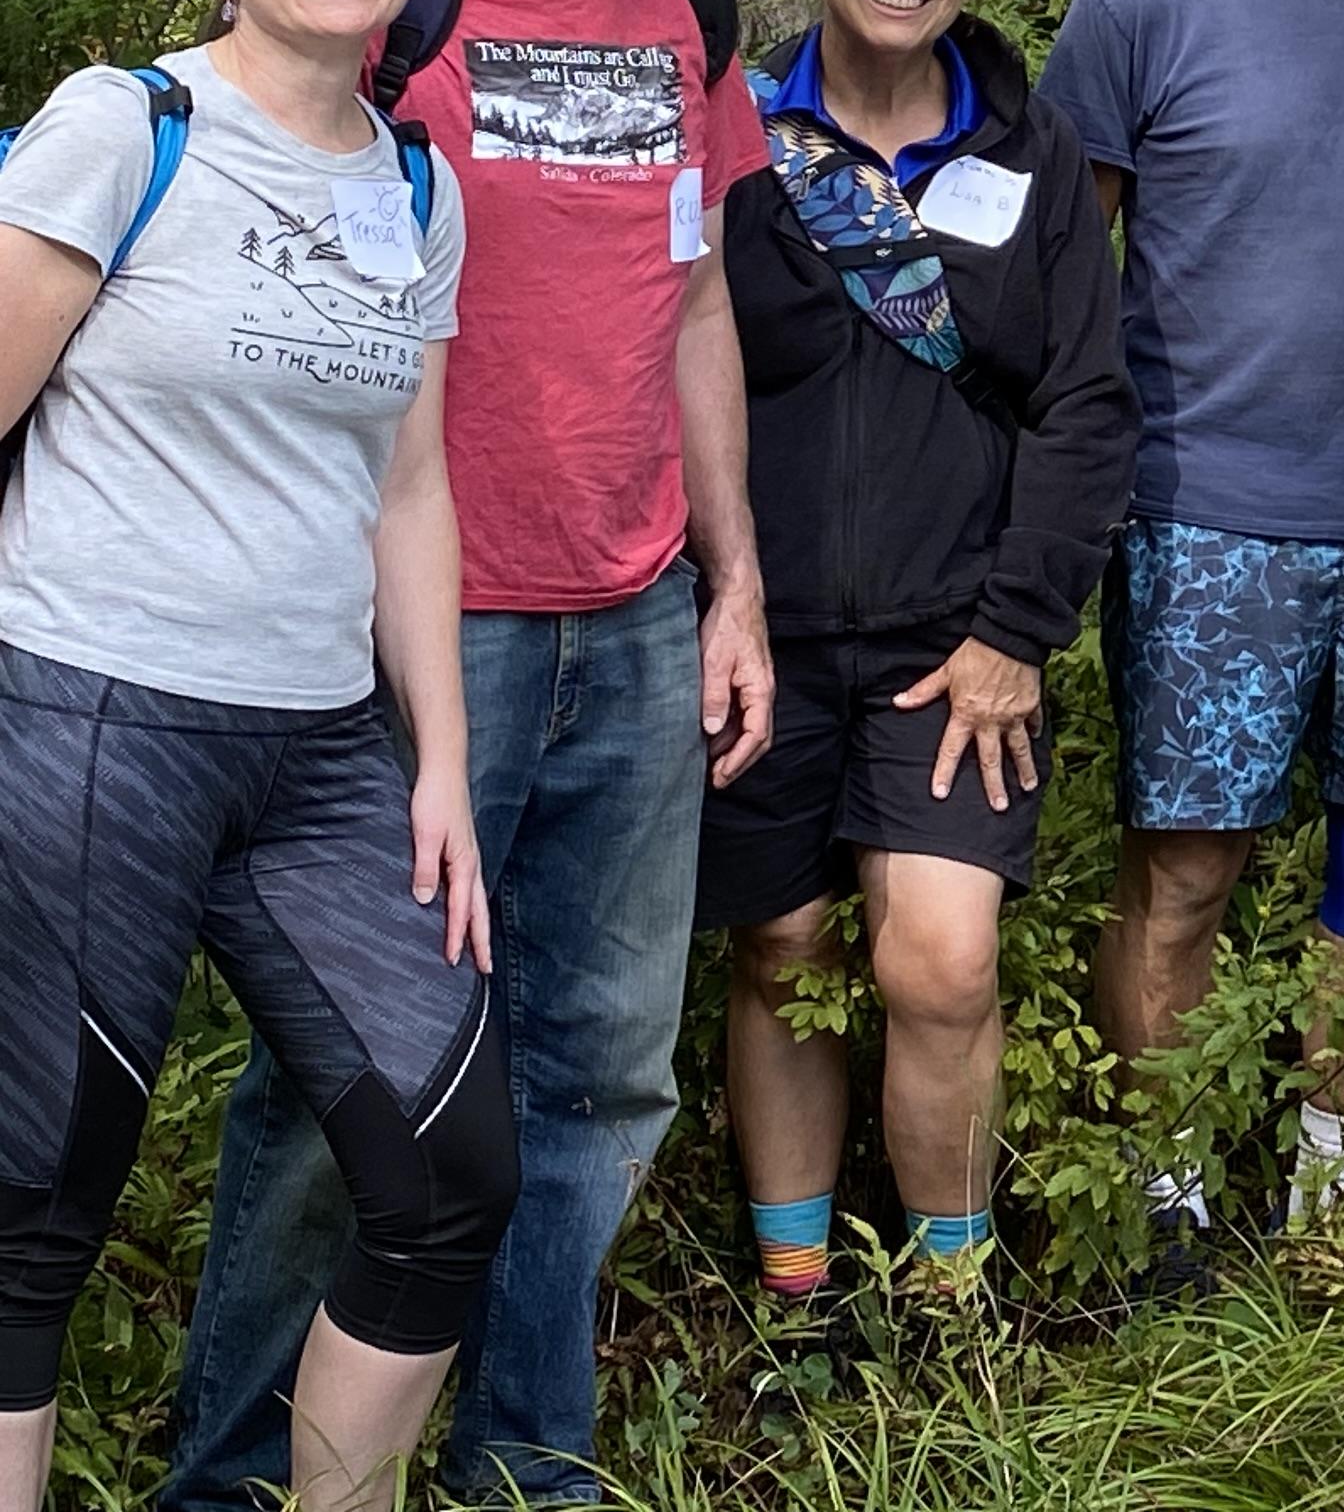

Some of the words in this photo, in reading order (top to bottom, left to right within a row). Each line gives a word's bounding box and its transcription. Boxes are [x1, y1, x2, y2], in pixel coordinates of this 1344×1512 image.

[475, 41, 513, 62] The
[514, 43, 602, 65] Mountains
[529, 65, 561, 83] and
[229, 340, 263, 363] TO
[274, 347, 332, 383] THE
[358, 338, 407, 366] LET'S
